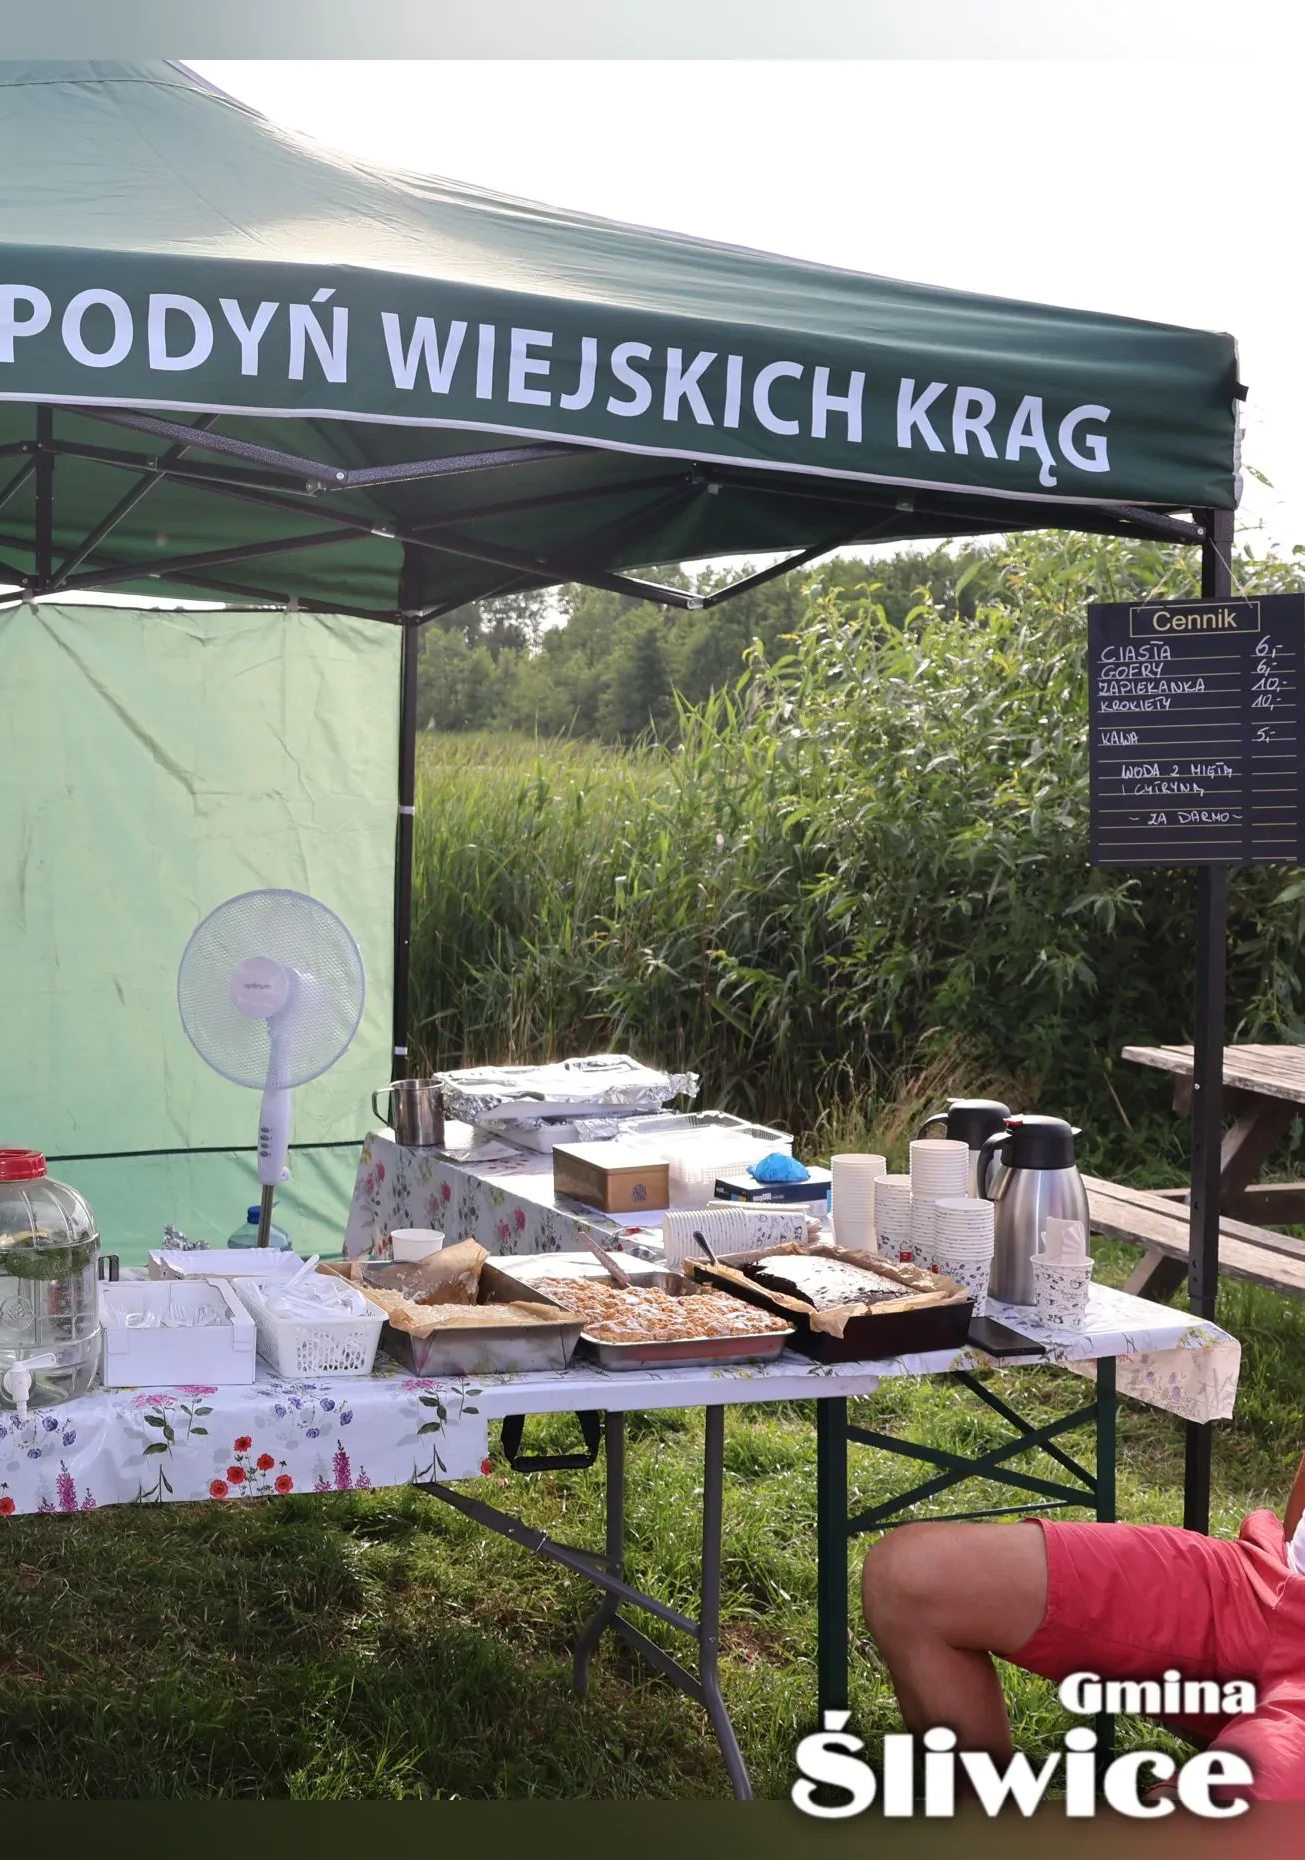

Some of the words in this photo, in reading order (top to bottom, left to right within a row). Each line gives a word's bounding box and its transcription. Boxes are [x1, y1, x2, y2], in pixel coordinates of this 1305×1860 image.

[380, 311, 867, 443] WIEJSKICH
[896, 377, 1112, 488] KRĄG
[1152, 609, 1238, 631] Cennik
[1101, 641, 1171, 662] CIASTA
[1101, 662, 1164, 679] GOFRY
[1099, 678, 1206, 696] ZAPIEKANKA
[1100, 696, 1171, 712] KROKIETY
[1101, 730, 1139, 746] KAWA
[1121, 763, 1160, 778] WODA
[1191, 761, 1233, 779] MIĘTĄ
[1148, 812, 1167, 824] ZA
[1178, 811, 1230, 824] DARMO
